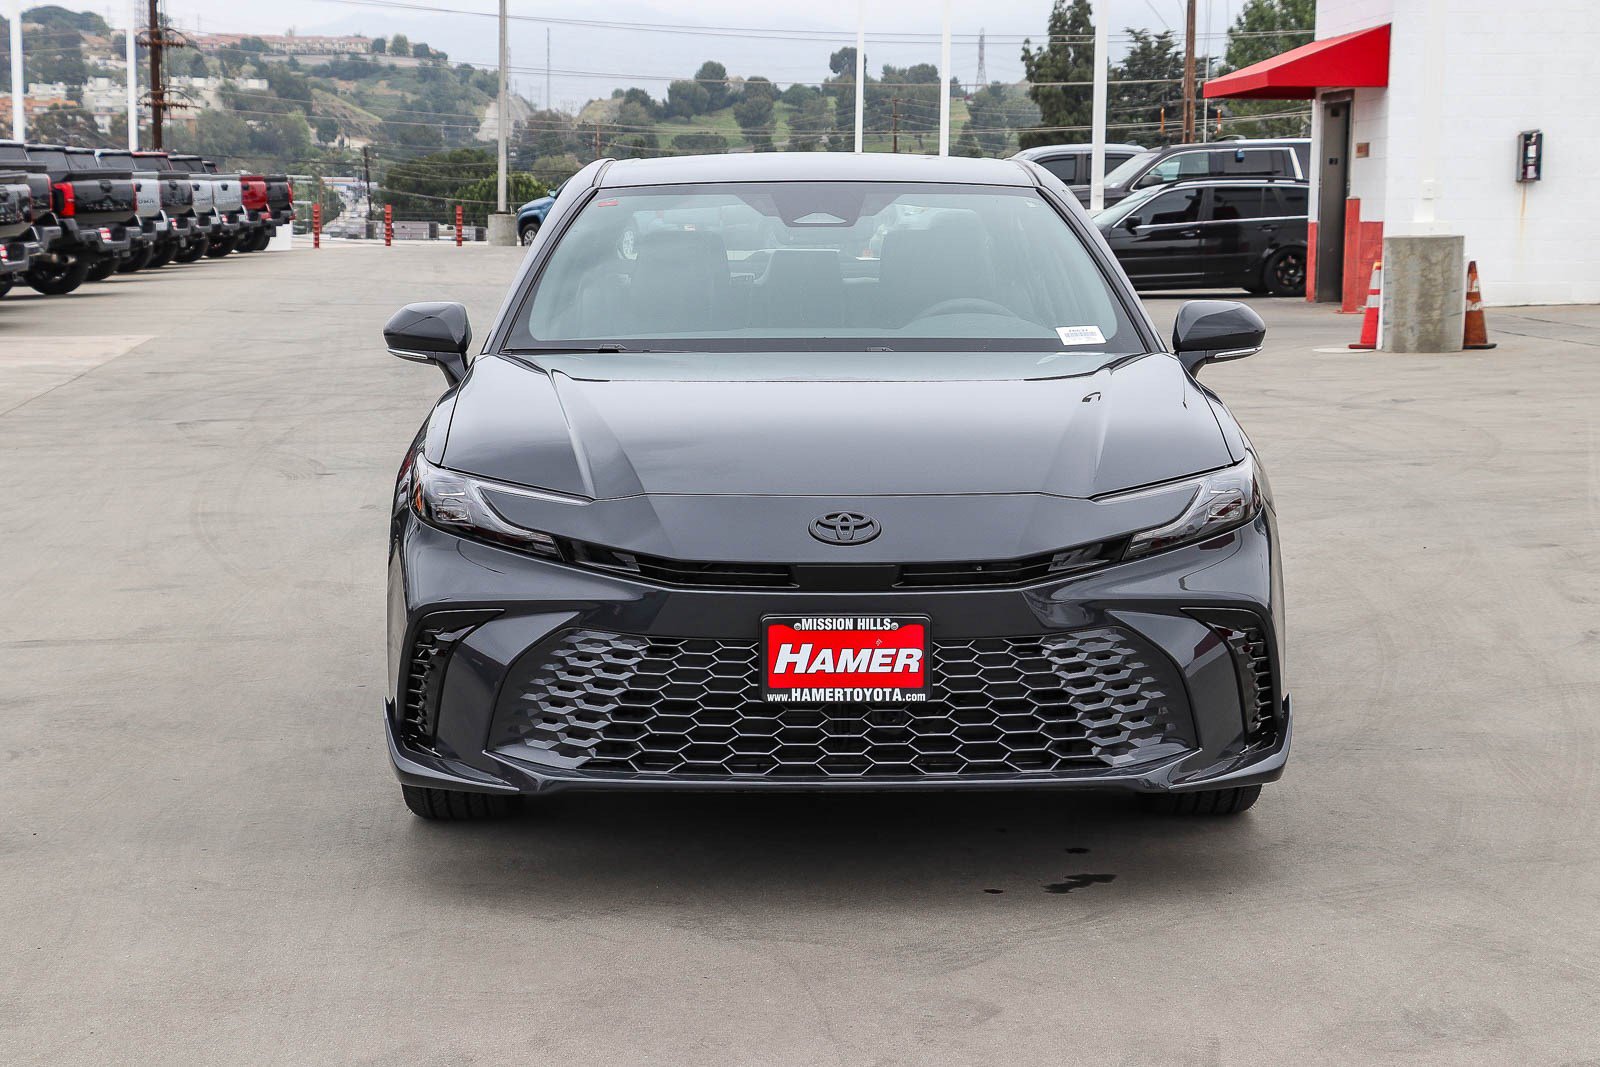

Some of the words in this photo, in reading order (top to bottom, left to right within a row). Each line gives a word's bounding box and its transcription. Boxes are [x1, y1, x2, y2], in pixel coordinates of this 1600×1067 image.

[801, 618, 853, 630] MISSION
[857, 618, 891, 630] HILLS
[773, 643, 923, 674] HAMER
[767, 688, 926, 702] www.HAMERTOYOTA.com
